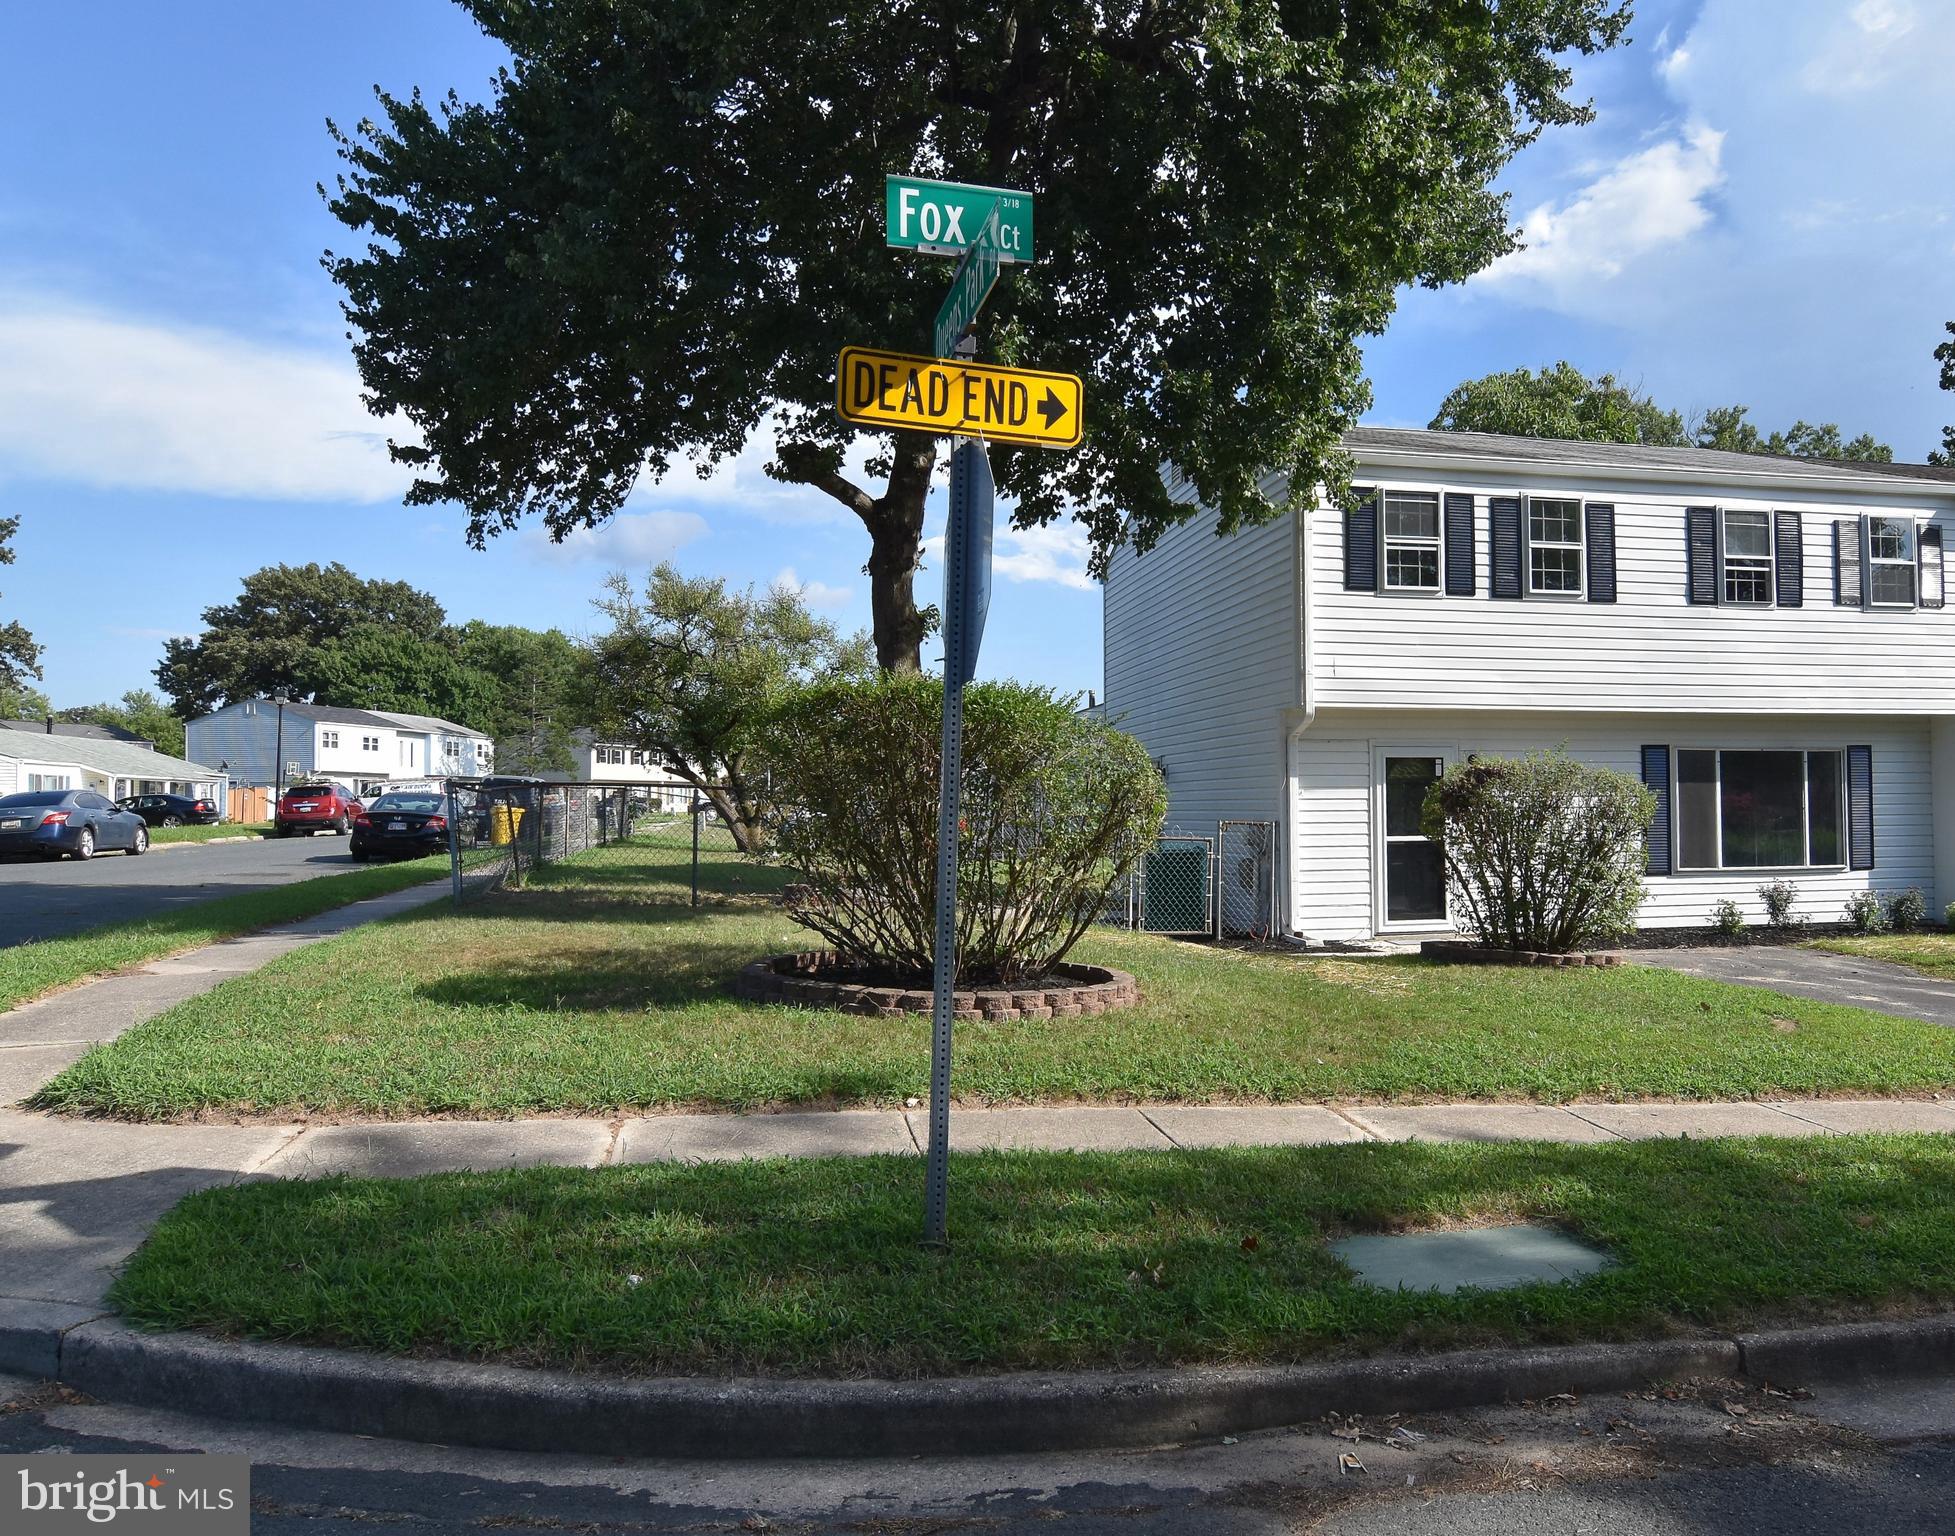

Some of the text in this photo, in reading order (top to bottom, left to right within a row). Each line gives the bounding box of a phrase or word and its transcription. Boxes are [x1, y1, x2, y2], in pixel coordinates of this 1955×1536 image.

[899, 187, 1020, 251] Fox Ct
[1003, 197, 1020, 209] 3/18
[965, 244, 984, 318] Park
[853, 360, 1029, 427] DEAD END
